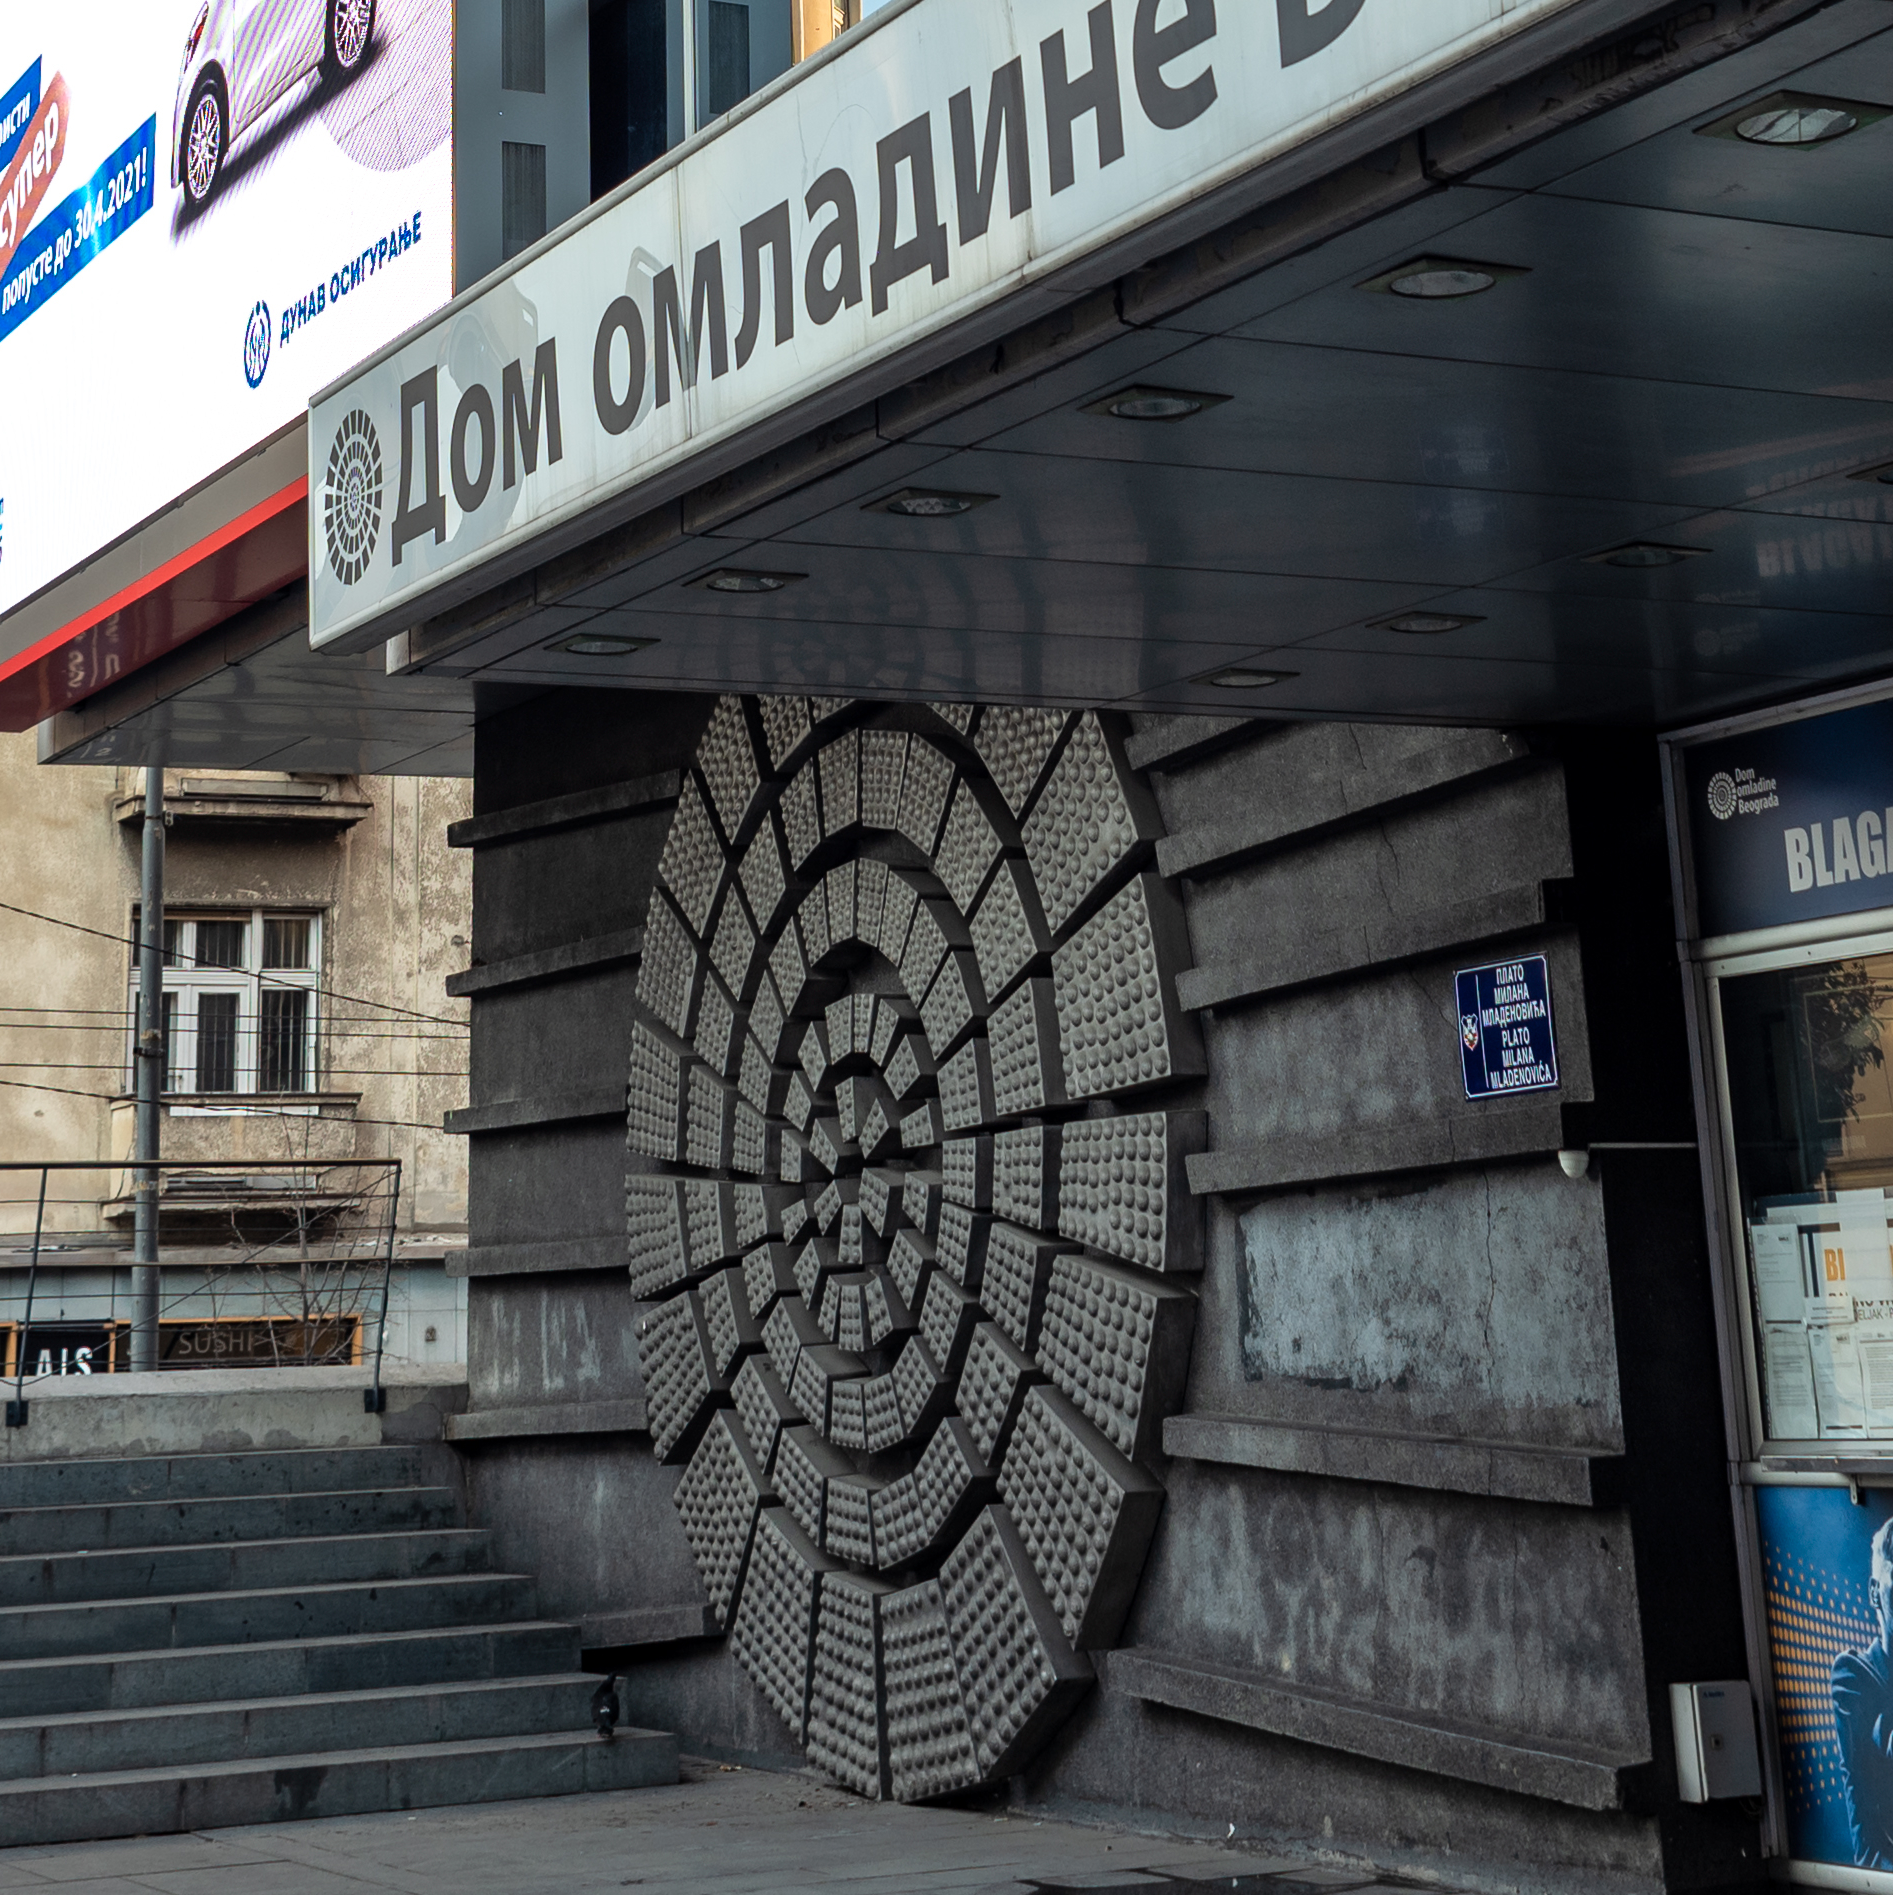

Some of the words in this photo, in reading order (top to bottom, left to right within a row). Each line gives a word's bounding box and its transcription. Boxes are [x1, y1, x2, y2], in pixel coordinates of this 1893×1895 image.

[2, 245, 53, 315] попусте
[54, 226, 72, 275] до
[74, 146, 147, 248] 30.4.2021!
[280, 283, 326, 348] ДУНАВ
[330, 210, 422, 303] ОСИГУРАЊЕ
[391, 342, 564, 568] Дом
[1734, 767, 1755, 781] Dom
[1736, 777, 1777, 797] omladine
[1738, 794, 1779, 815] Beograda
[1496, 964, 1524, 985] ПЛАТО
[1494, 983, 1529, 1005] МИЛАНА
[1482, 999, 1546, 1028] МЛАДЕНОВИЋА
[1502, 1026, 1530, 1048] PLATO
[1502, 1046, 1535, 1067] MILANA
[1490, 1060, 1552, 1089] MLADENOVIĆA
[178, 1330, 253, 1354] SUSHI
